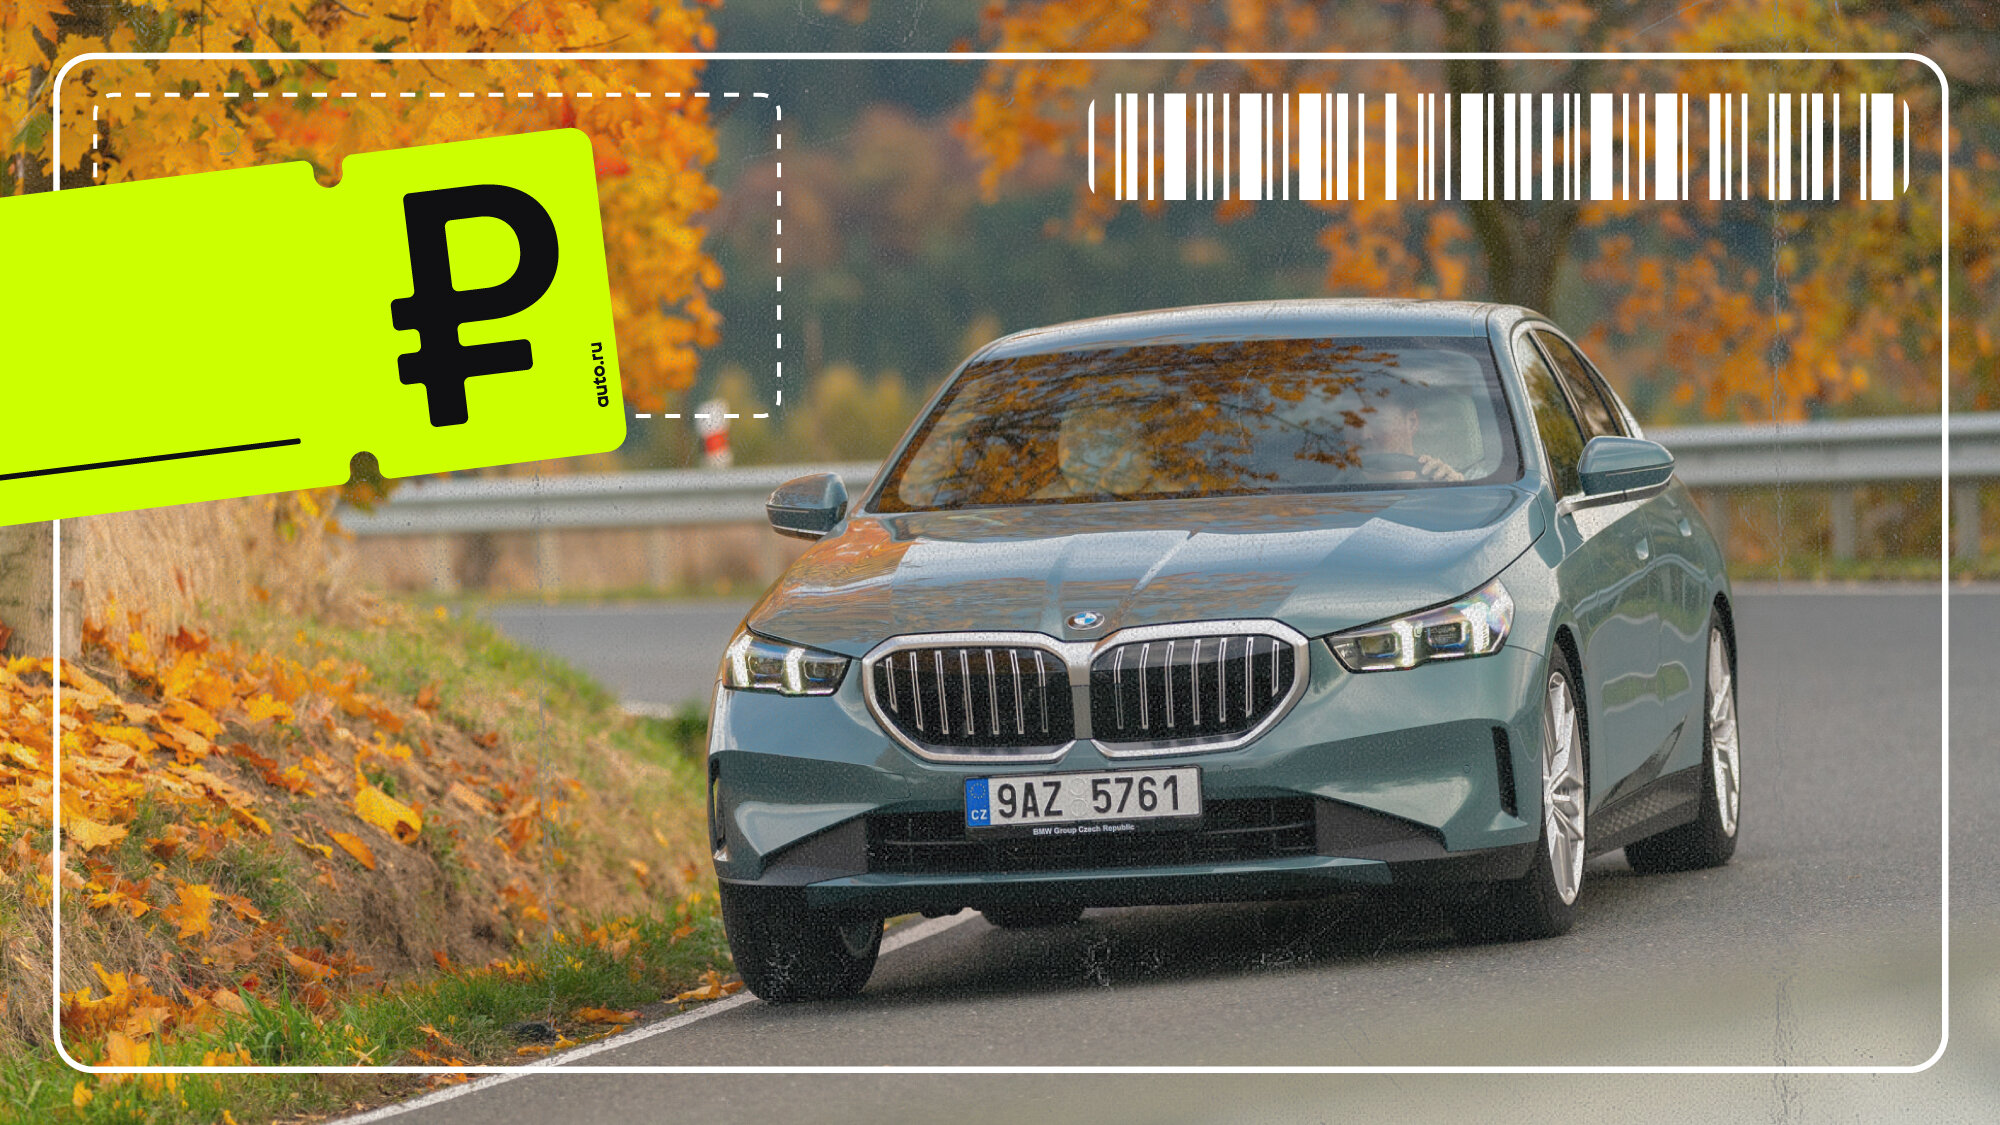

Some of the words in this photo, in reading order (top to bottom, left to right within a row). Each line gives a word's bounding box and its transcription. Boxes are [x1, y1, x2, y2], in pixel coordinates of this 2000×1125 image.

[997, 781, 1063, 818] 9AZ
[1091, 775, 1179, 814] 5761
[971, 809, 988, 820] CZ
[1033, 828, 1052, 836] BMW
[1053, 827, 1077, 835] Group
[1078, 825, 1101, 833] Czech
[1102, 823, 1135, 833] Republic
